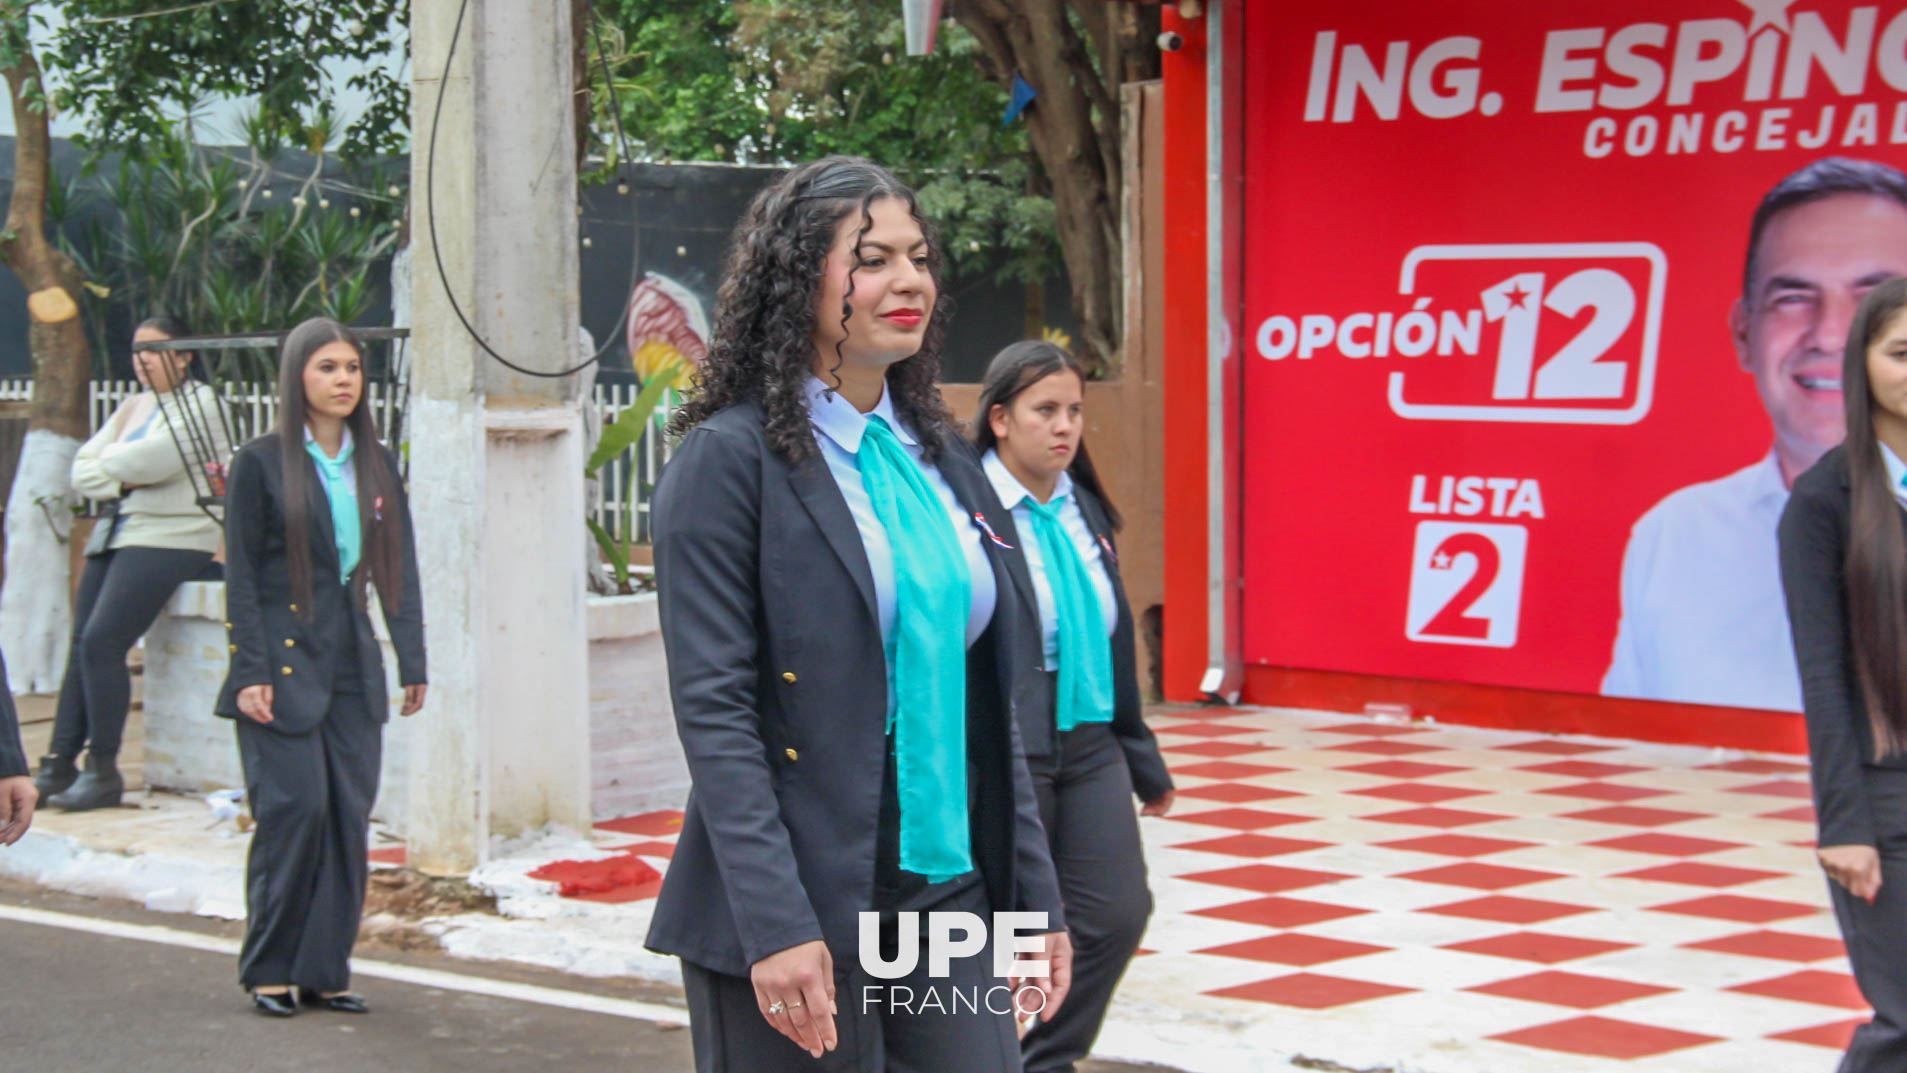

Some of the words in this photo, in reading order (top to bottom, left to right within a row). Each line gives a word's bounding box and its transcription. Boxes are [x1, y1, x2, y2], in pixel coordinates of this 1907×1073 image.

[1304, 31, 1503, 122] ING.
[1256, 297, 1483, 360] OPCIÓN
[1480, 268, 1636, 399] 12
[1408, 475, 1545, 518] LISTA
[1416, 532, 1500, 639] 2
